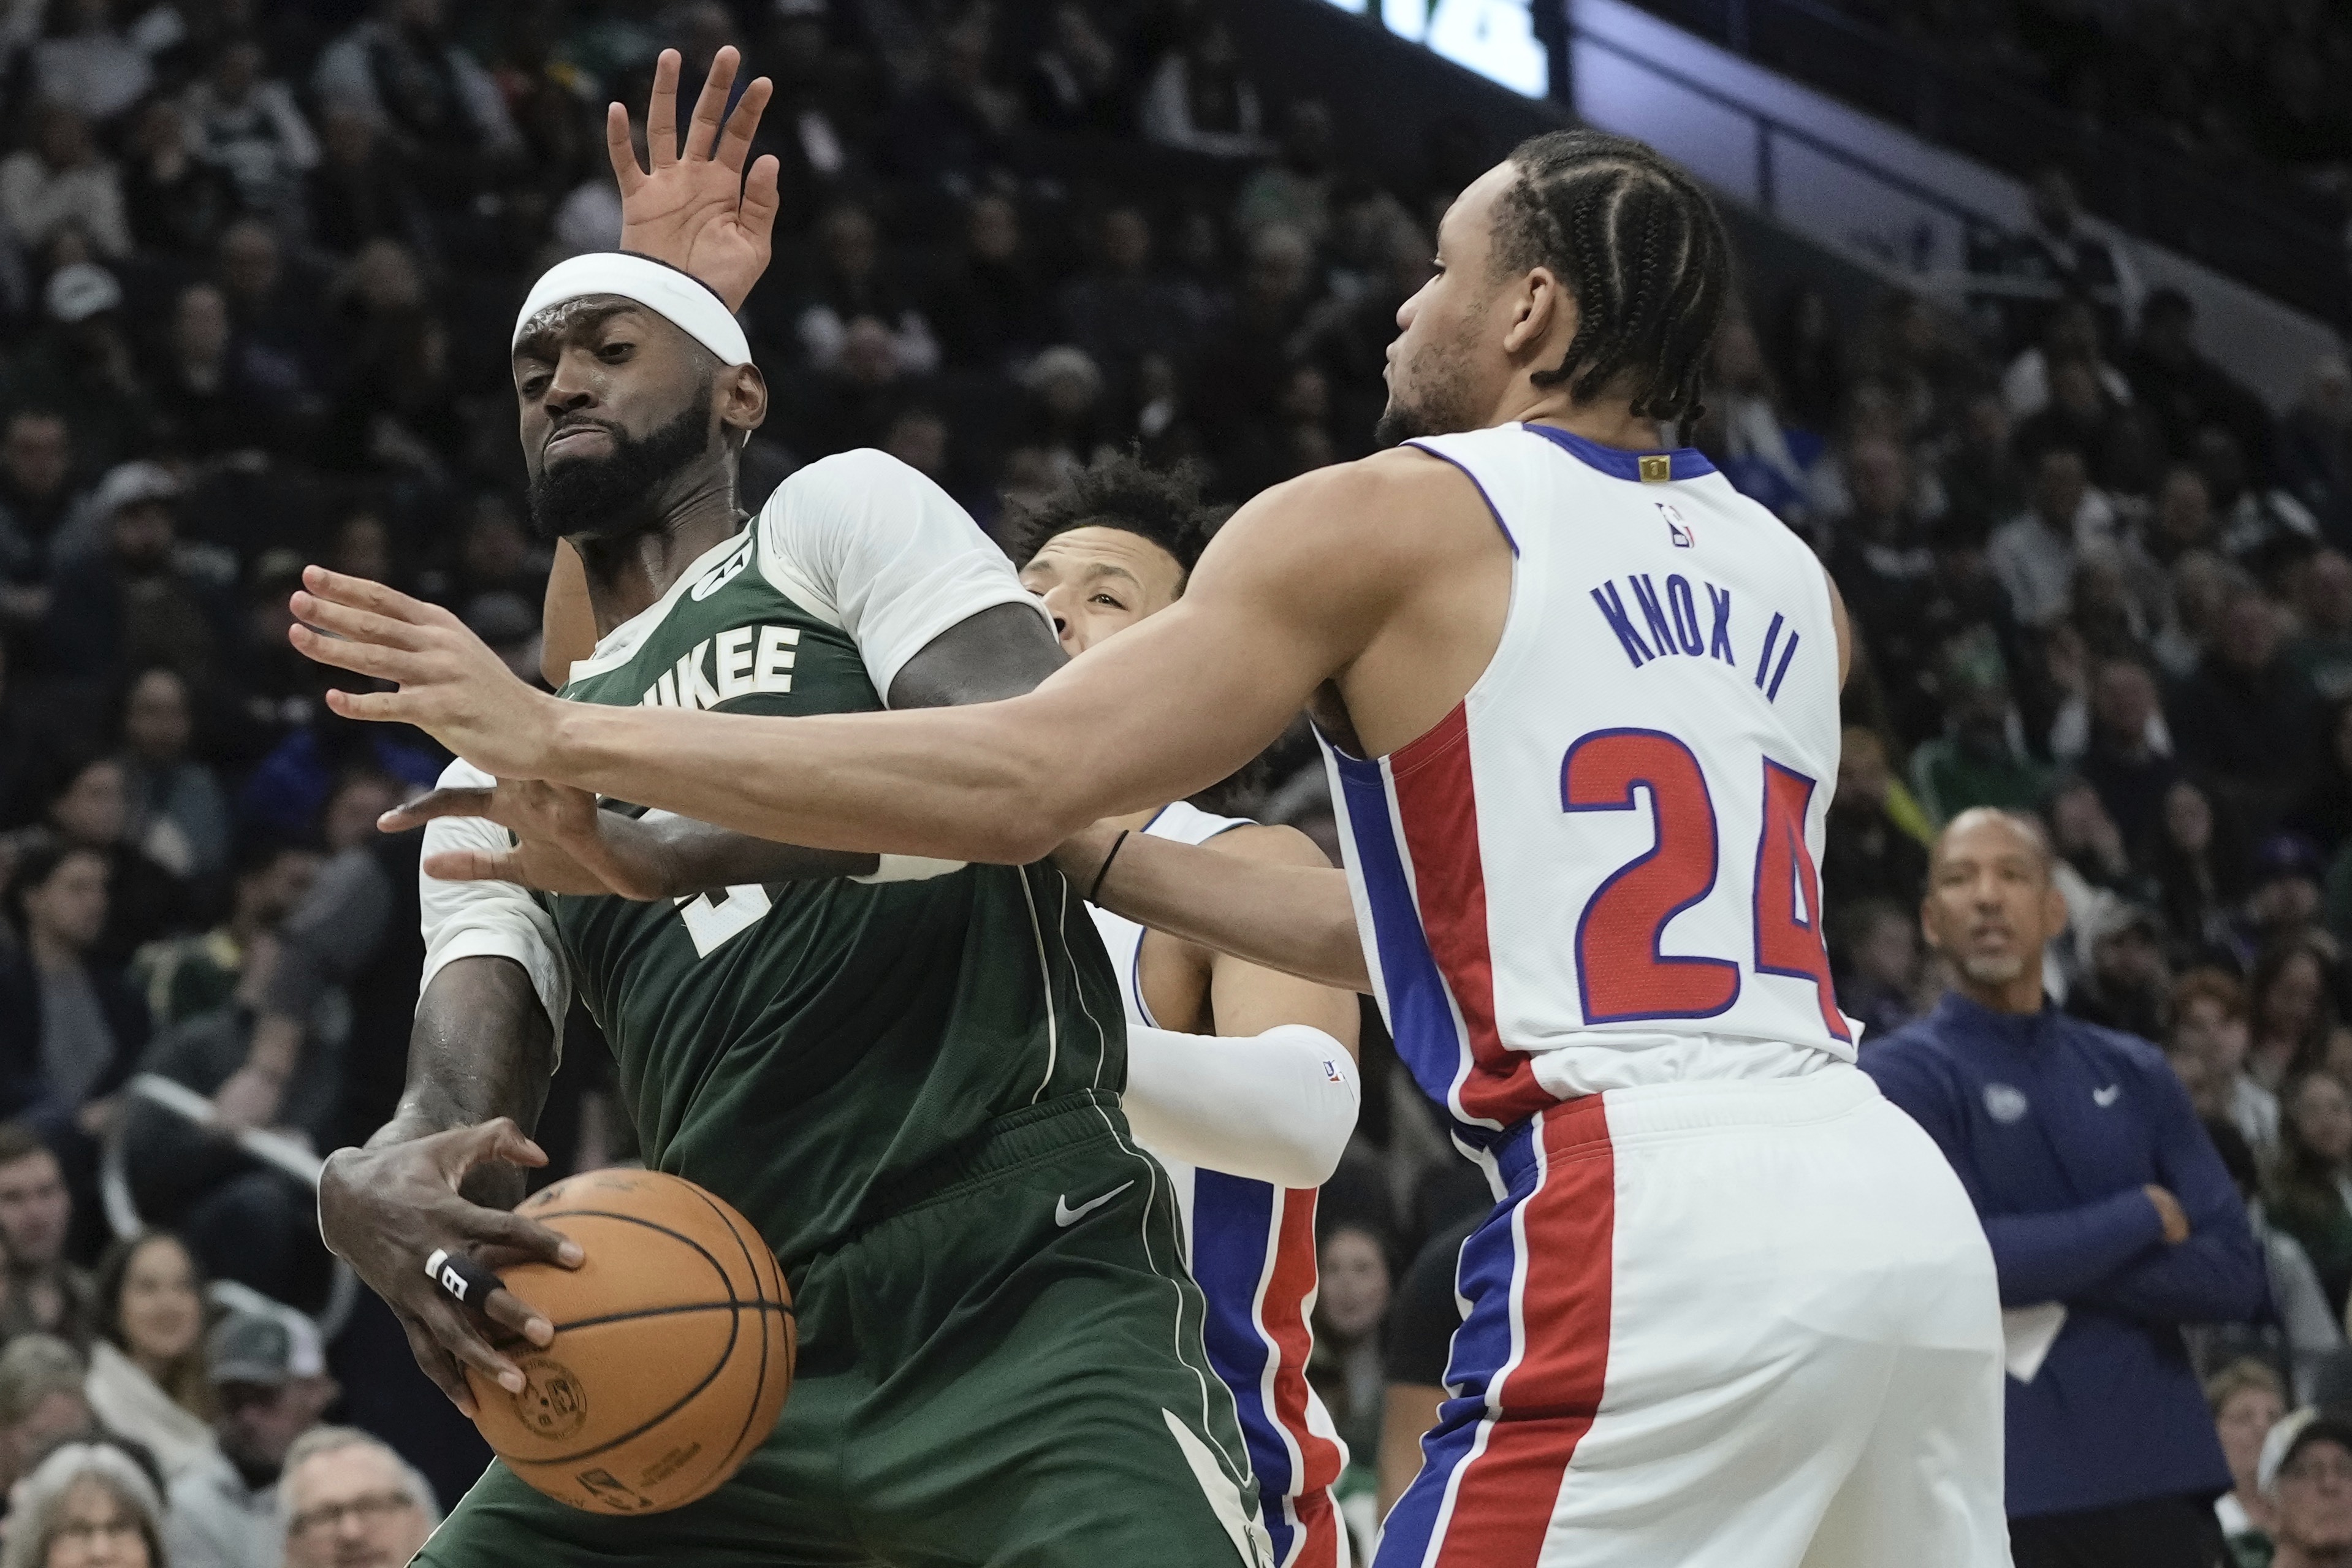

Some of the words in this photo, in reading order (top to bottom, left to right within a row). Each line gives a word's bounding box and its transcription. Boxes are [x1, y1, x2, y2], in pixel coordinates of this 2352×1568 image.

[637, 625, 800, 710] UKEE
[1589, 574, 1735, 669] KNOX
[1755, 612, 1799, 704] II
[1561, 727, 1853, 1043] 24
